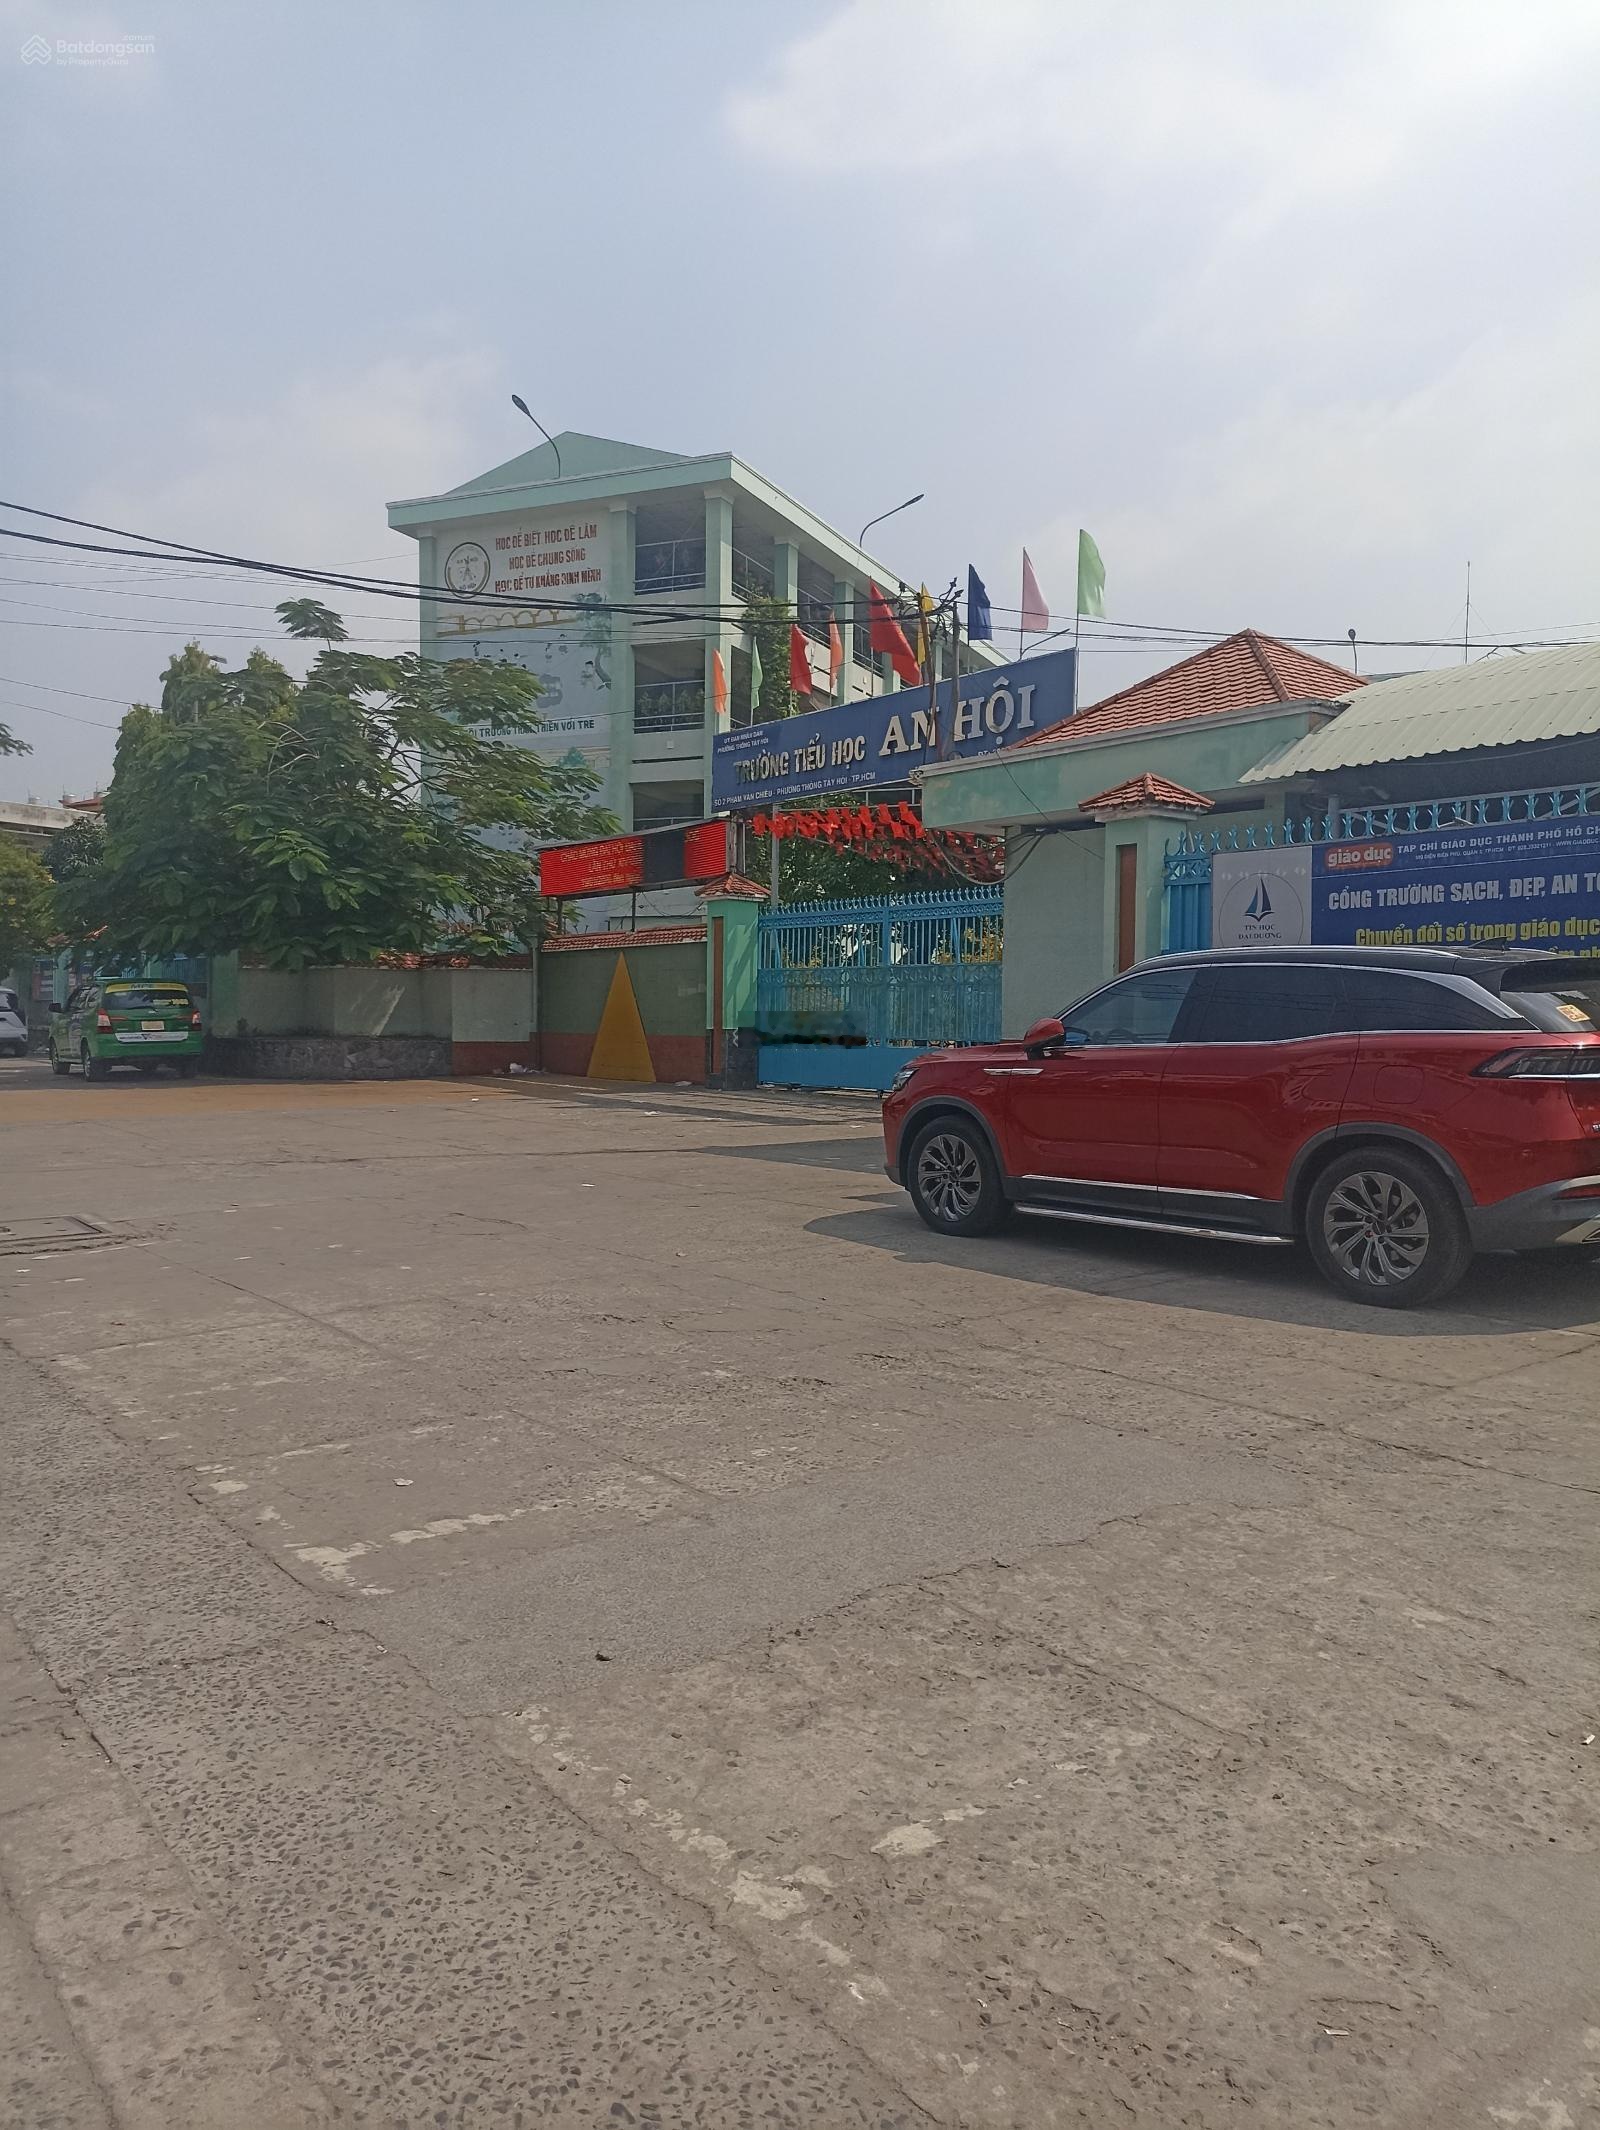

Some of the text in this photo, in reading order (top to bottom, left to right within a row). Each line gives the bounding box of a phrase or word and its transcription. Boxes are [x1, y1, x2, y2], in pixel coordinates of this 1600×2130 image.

[538, 551, 564, 567] CHUNG
[879, 676, 1035, 757] AN HỘI
[734, 733, 866, 785] TRƯỜNG TIỂU HỌC
[1441, 838, 1466, 850] GIÁO
[1496, 832, 1534, 844] THÀNH
[1538, 826, 1561, 840] PHỐ
[1328, 846, 1392, 868] giáo dục
[1328, 885, 1372, 910] CỔNG
[1377, 883, 1445, 907] TRƯỜNG
[1450, 880, 1504, 905] SẠCH,
[1509, 876, 1546, 900] ĐẸP,
[1551, 873, 1578, 895] AN
[1355, 916, 1600, 946] Chuyển đổi số trong giáo dục
